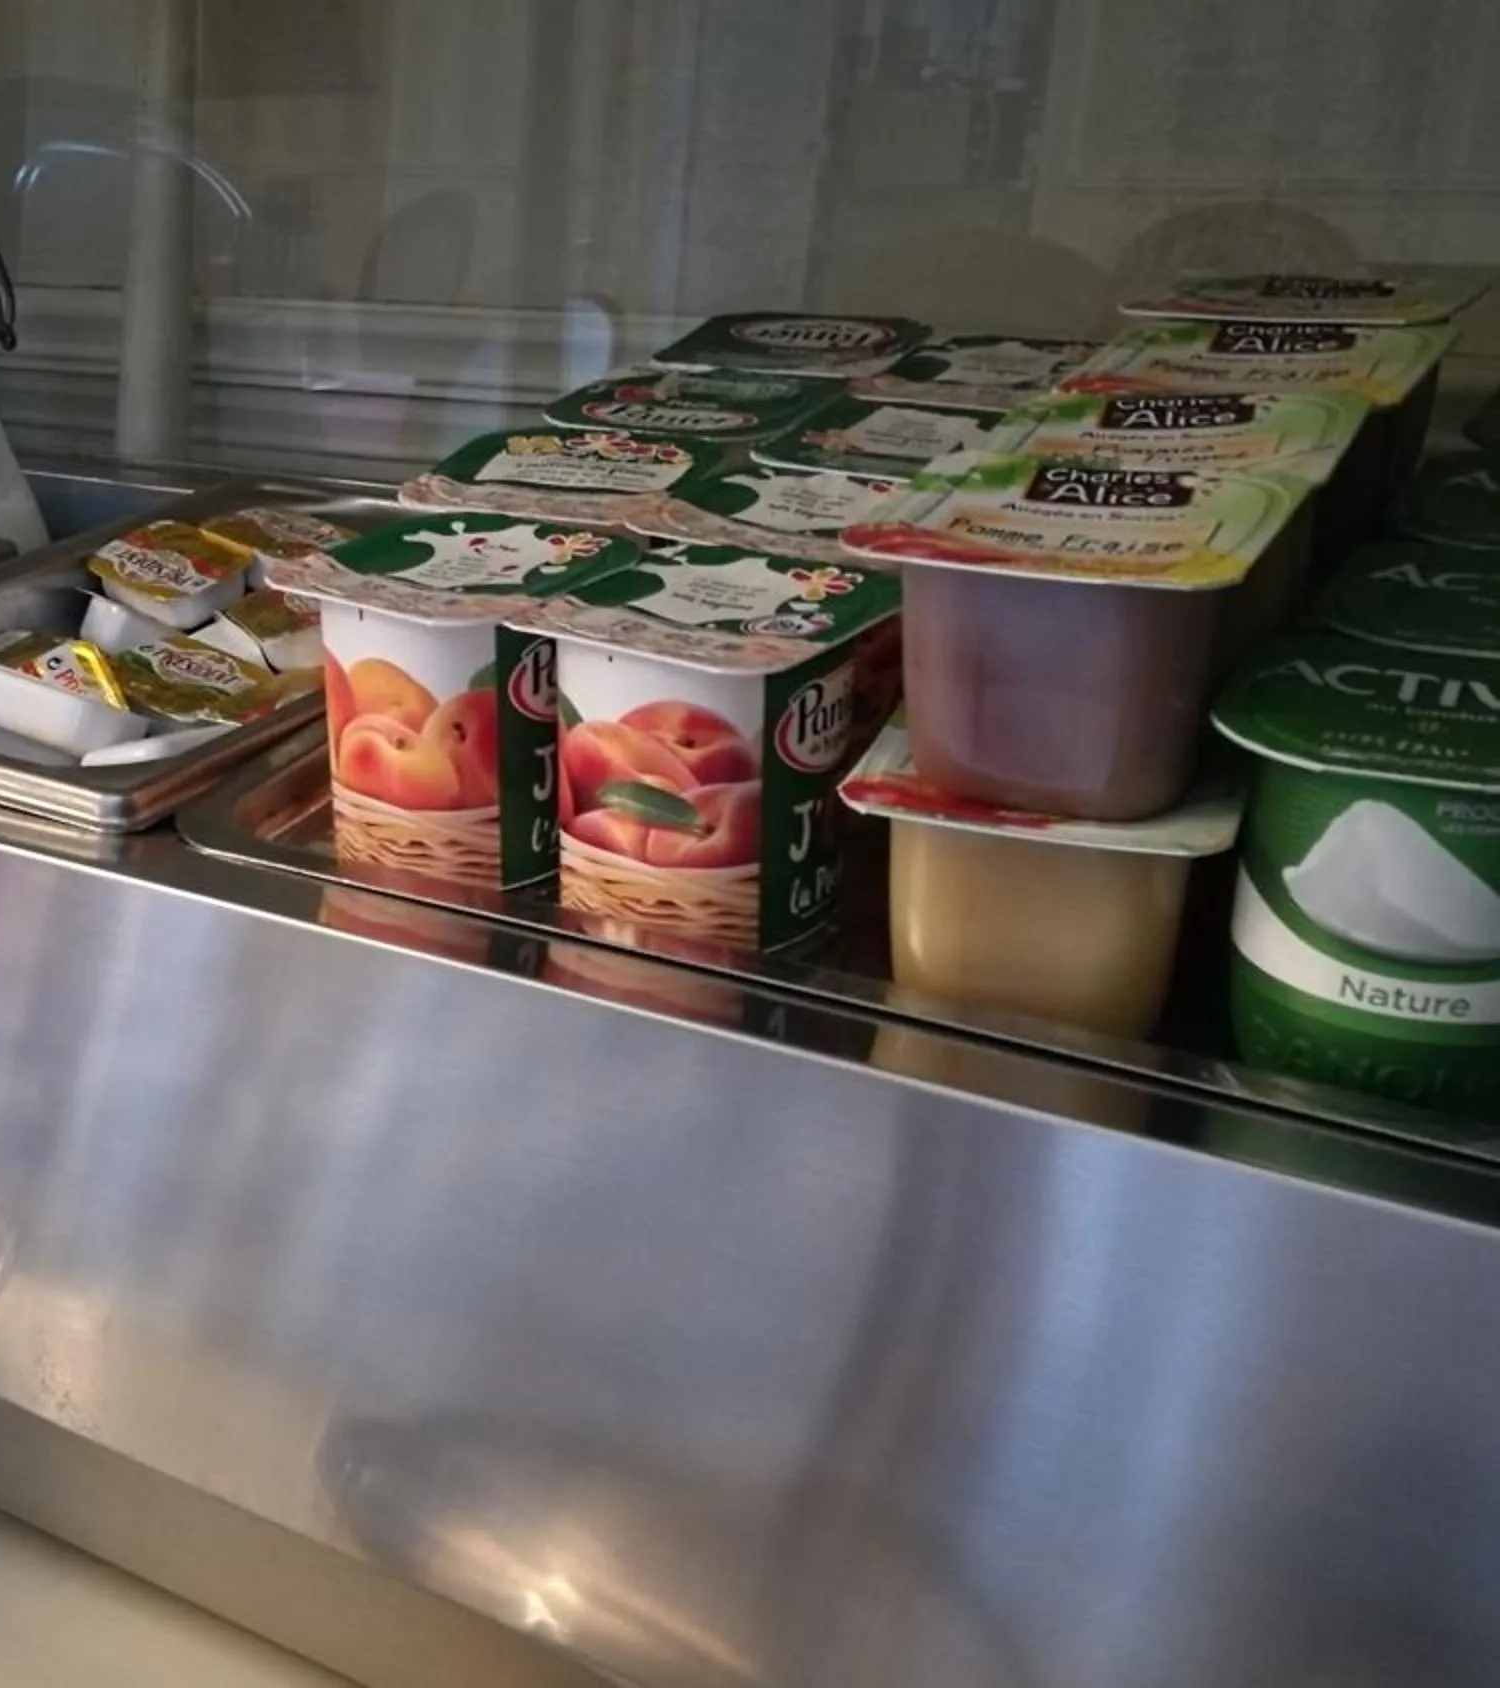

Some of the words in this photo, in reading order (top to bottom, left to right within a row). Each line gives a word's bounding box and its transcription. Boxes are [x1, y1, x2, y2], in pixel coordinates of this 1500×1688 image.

[1229, 335, 1339, 352] Alice
[1121, 409, 1238, 428] Alice
[1045, 466, 1172, 486] Charles
[1048, 483, 1174, 506] Alice
[948, 516, 1046, 546] Pomme
[1060, 532, 1186, 555] Fraise
[1338, 972, 1472, 1020] Nature
